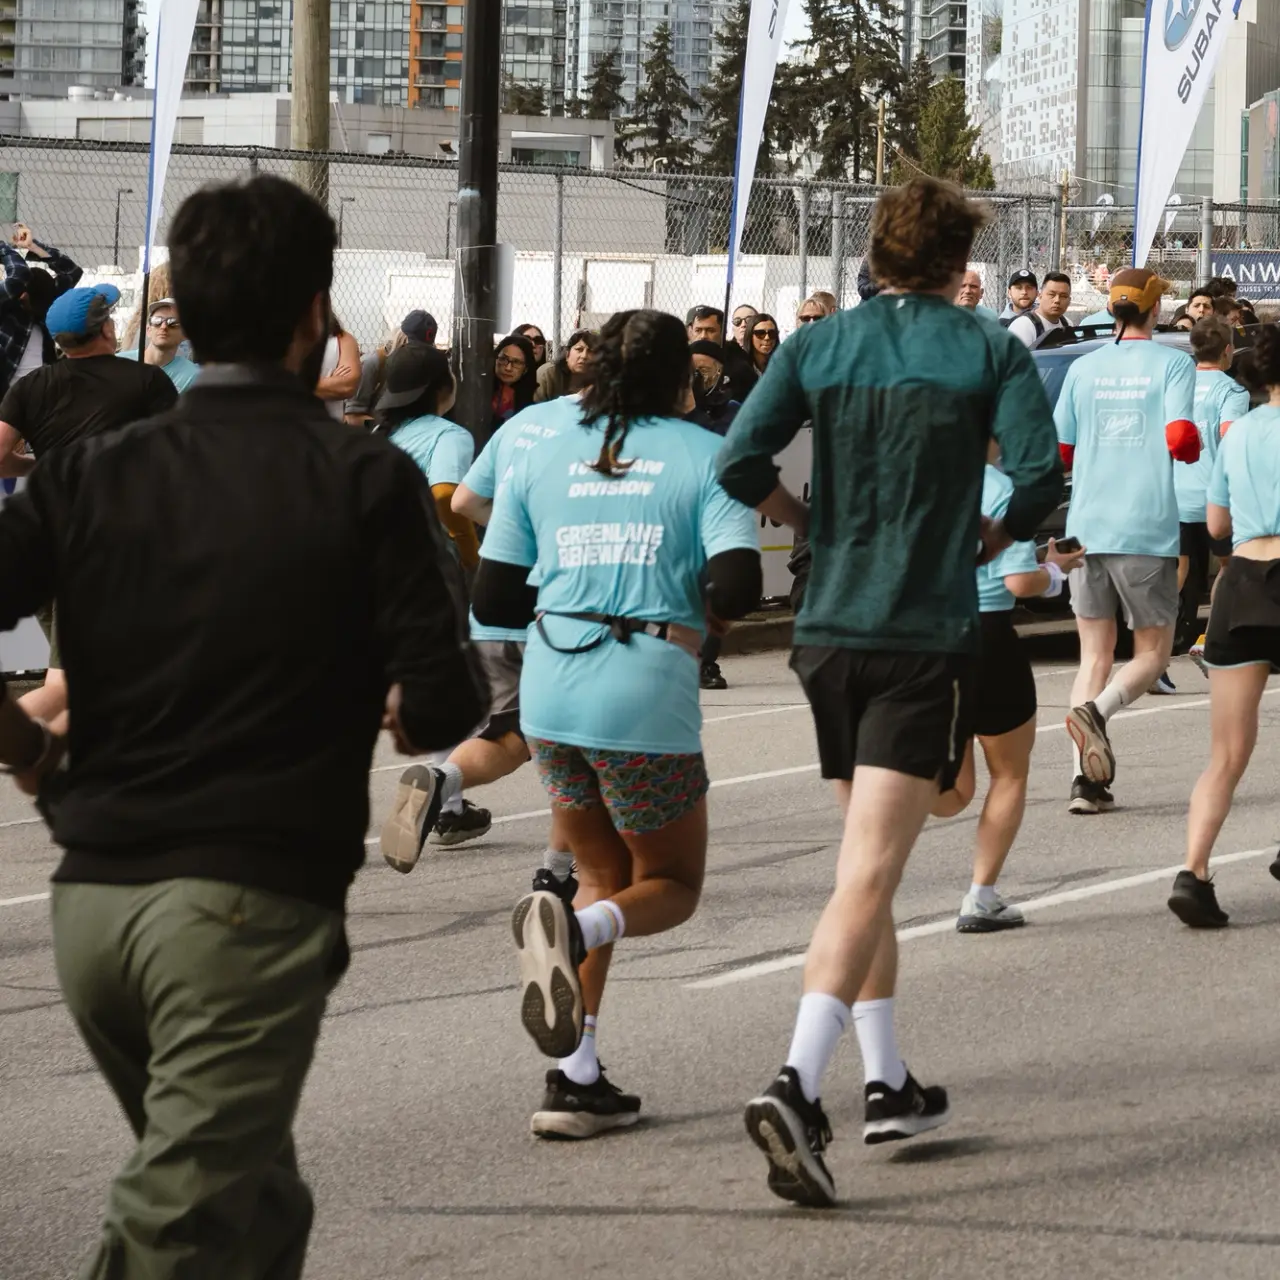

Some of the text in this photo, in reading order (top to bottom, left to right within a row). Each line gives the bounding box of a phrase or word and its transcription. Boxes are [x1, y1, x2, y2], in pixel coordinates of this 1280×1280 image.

[1095, 389, 1147, 400] DIVISION
[568, 480, 656, 498] DIVISION
[555, 522, 665, 547] GREENLANE
